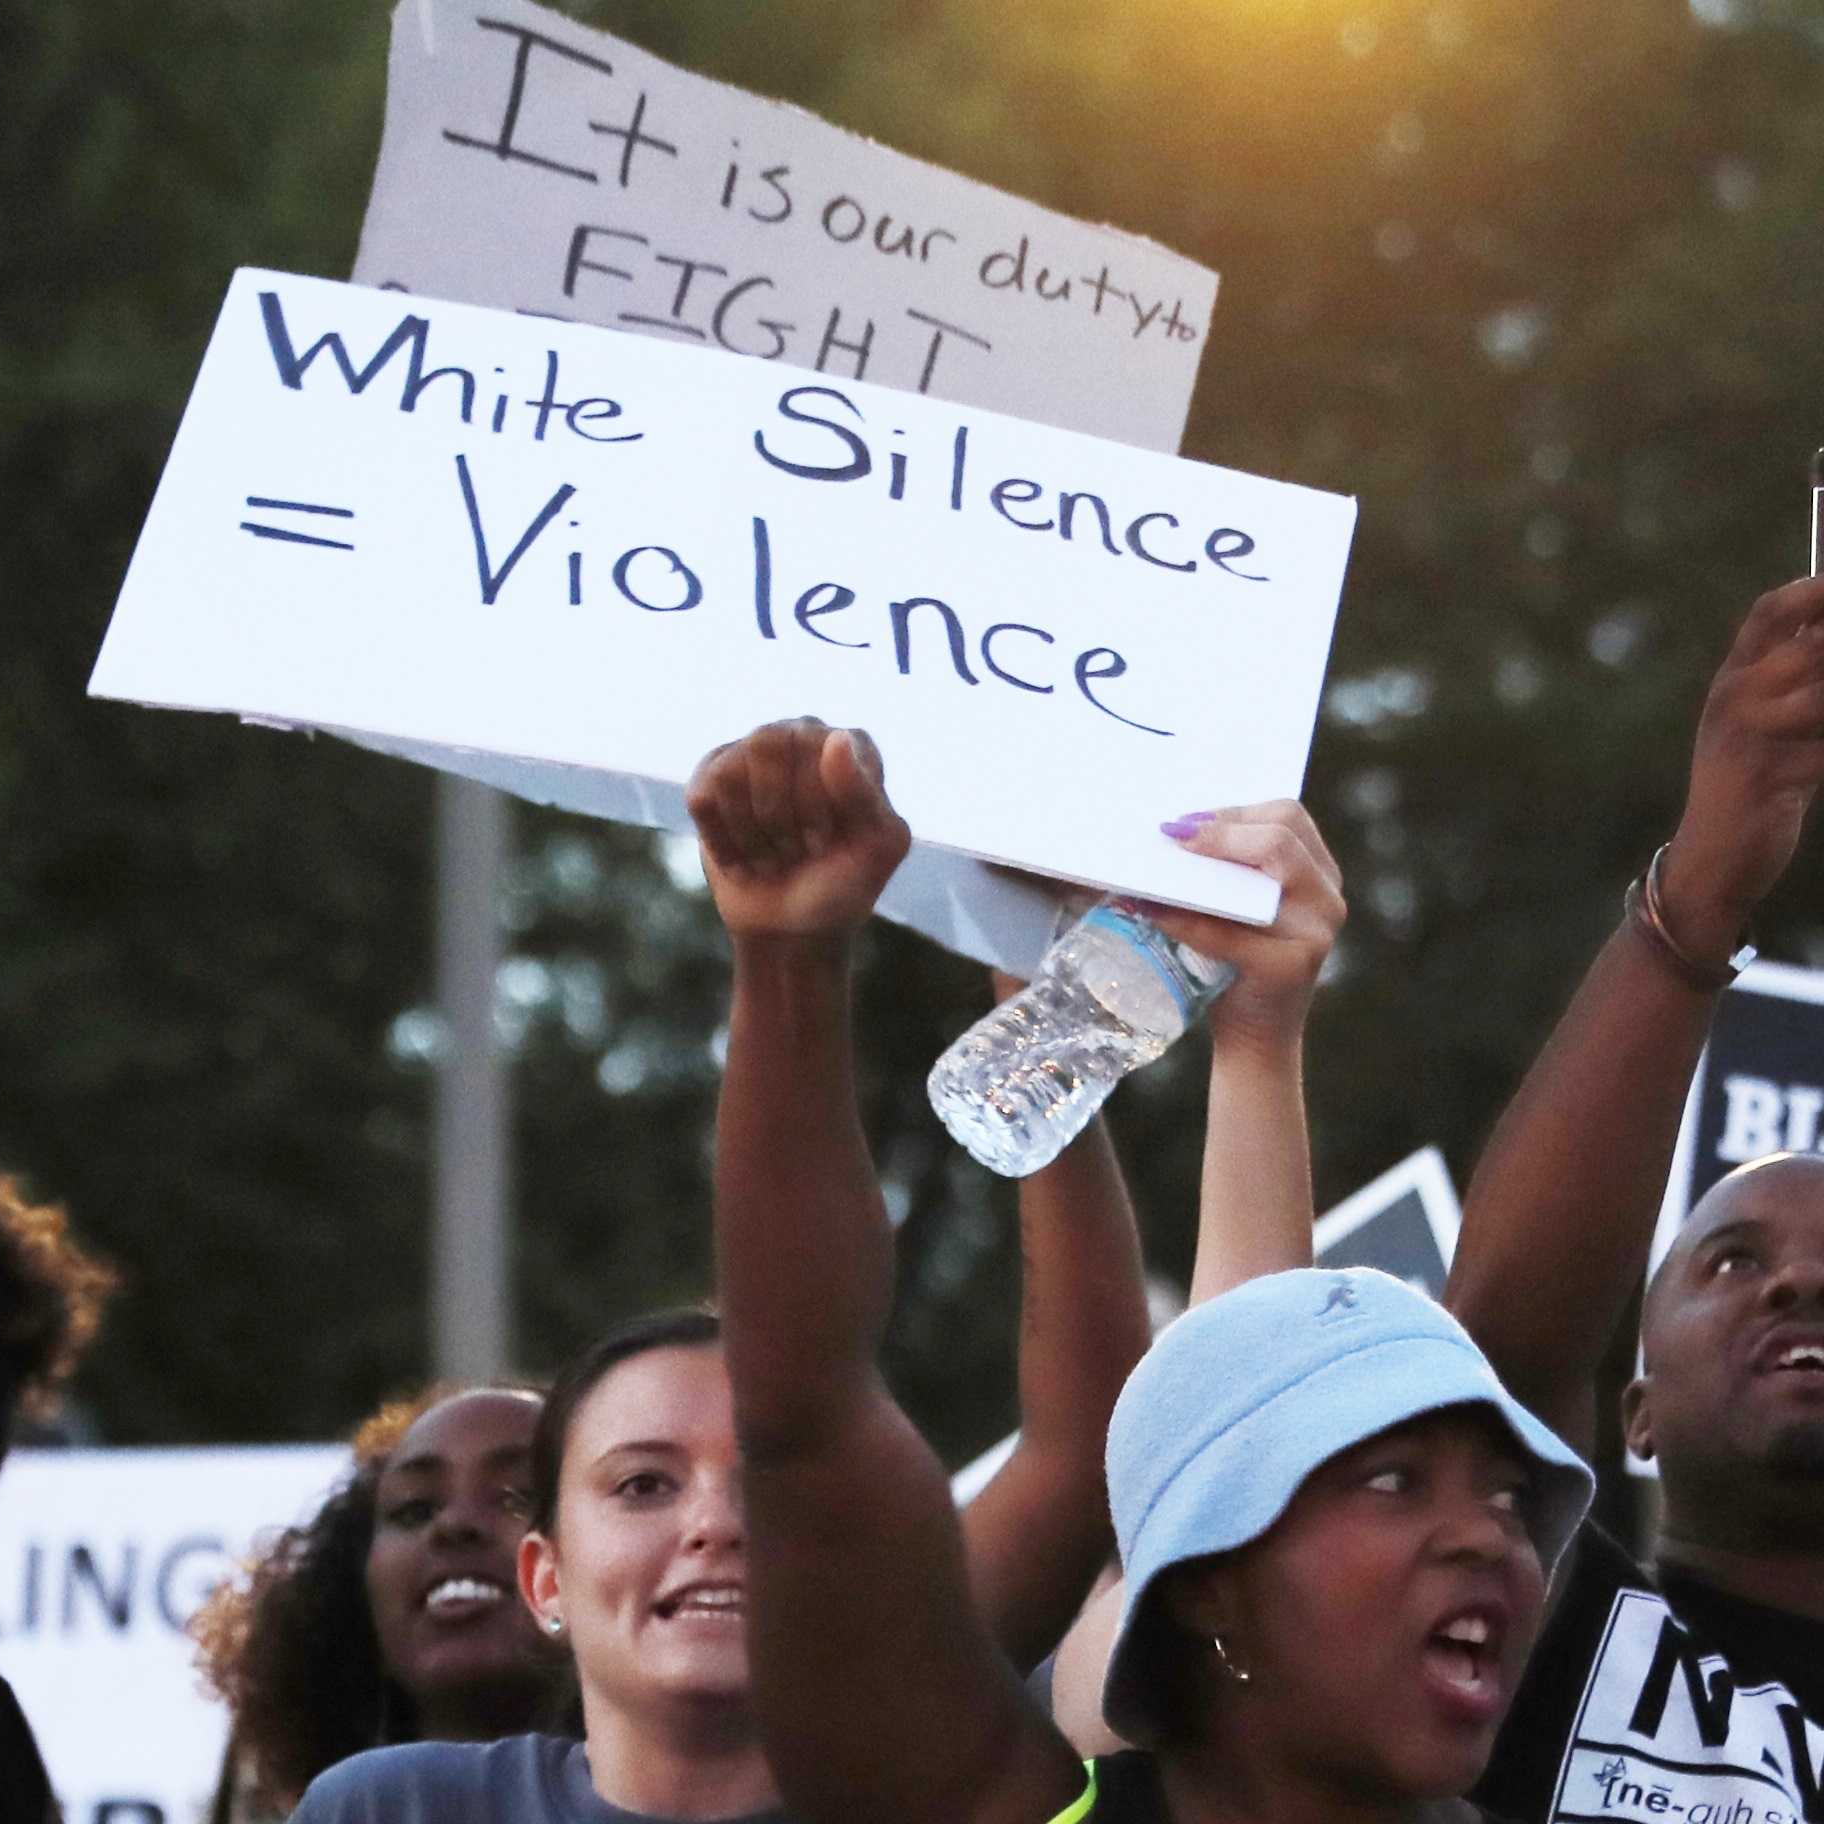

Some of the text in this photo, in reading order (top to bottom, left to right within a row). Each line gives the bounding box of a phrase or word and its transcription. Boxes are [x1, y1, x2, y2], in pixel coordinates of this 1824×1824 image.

[441, 15, 1198, 345] It is our duty to
[561, 224, 993, 394] FIGHT
[259, 292, 1272, 583] White Silence
[454, 454, 1176, 737] Violence
